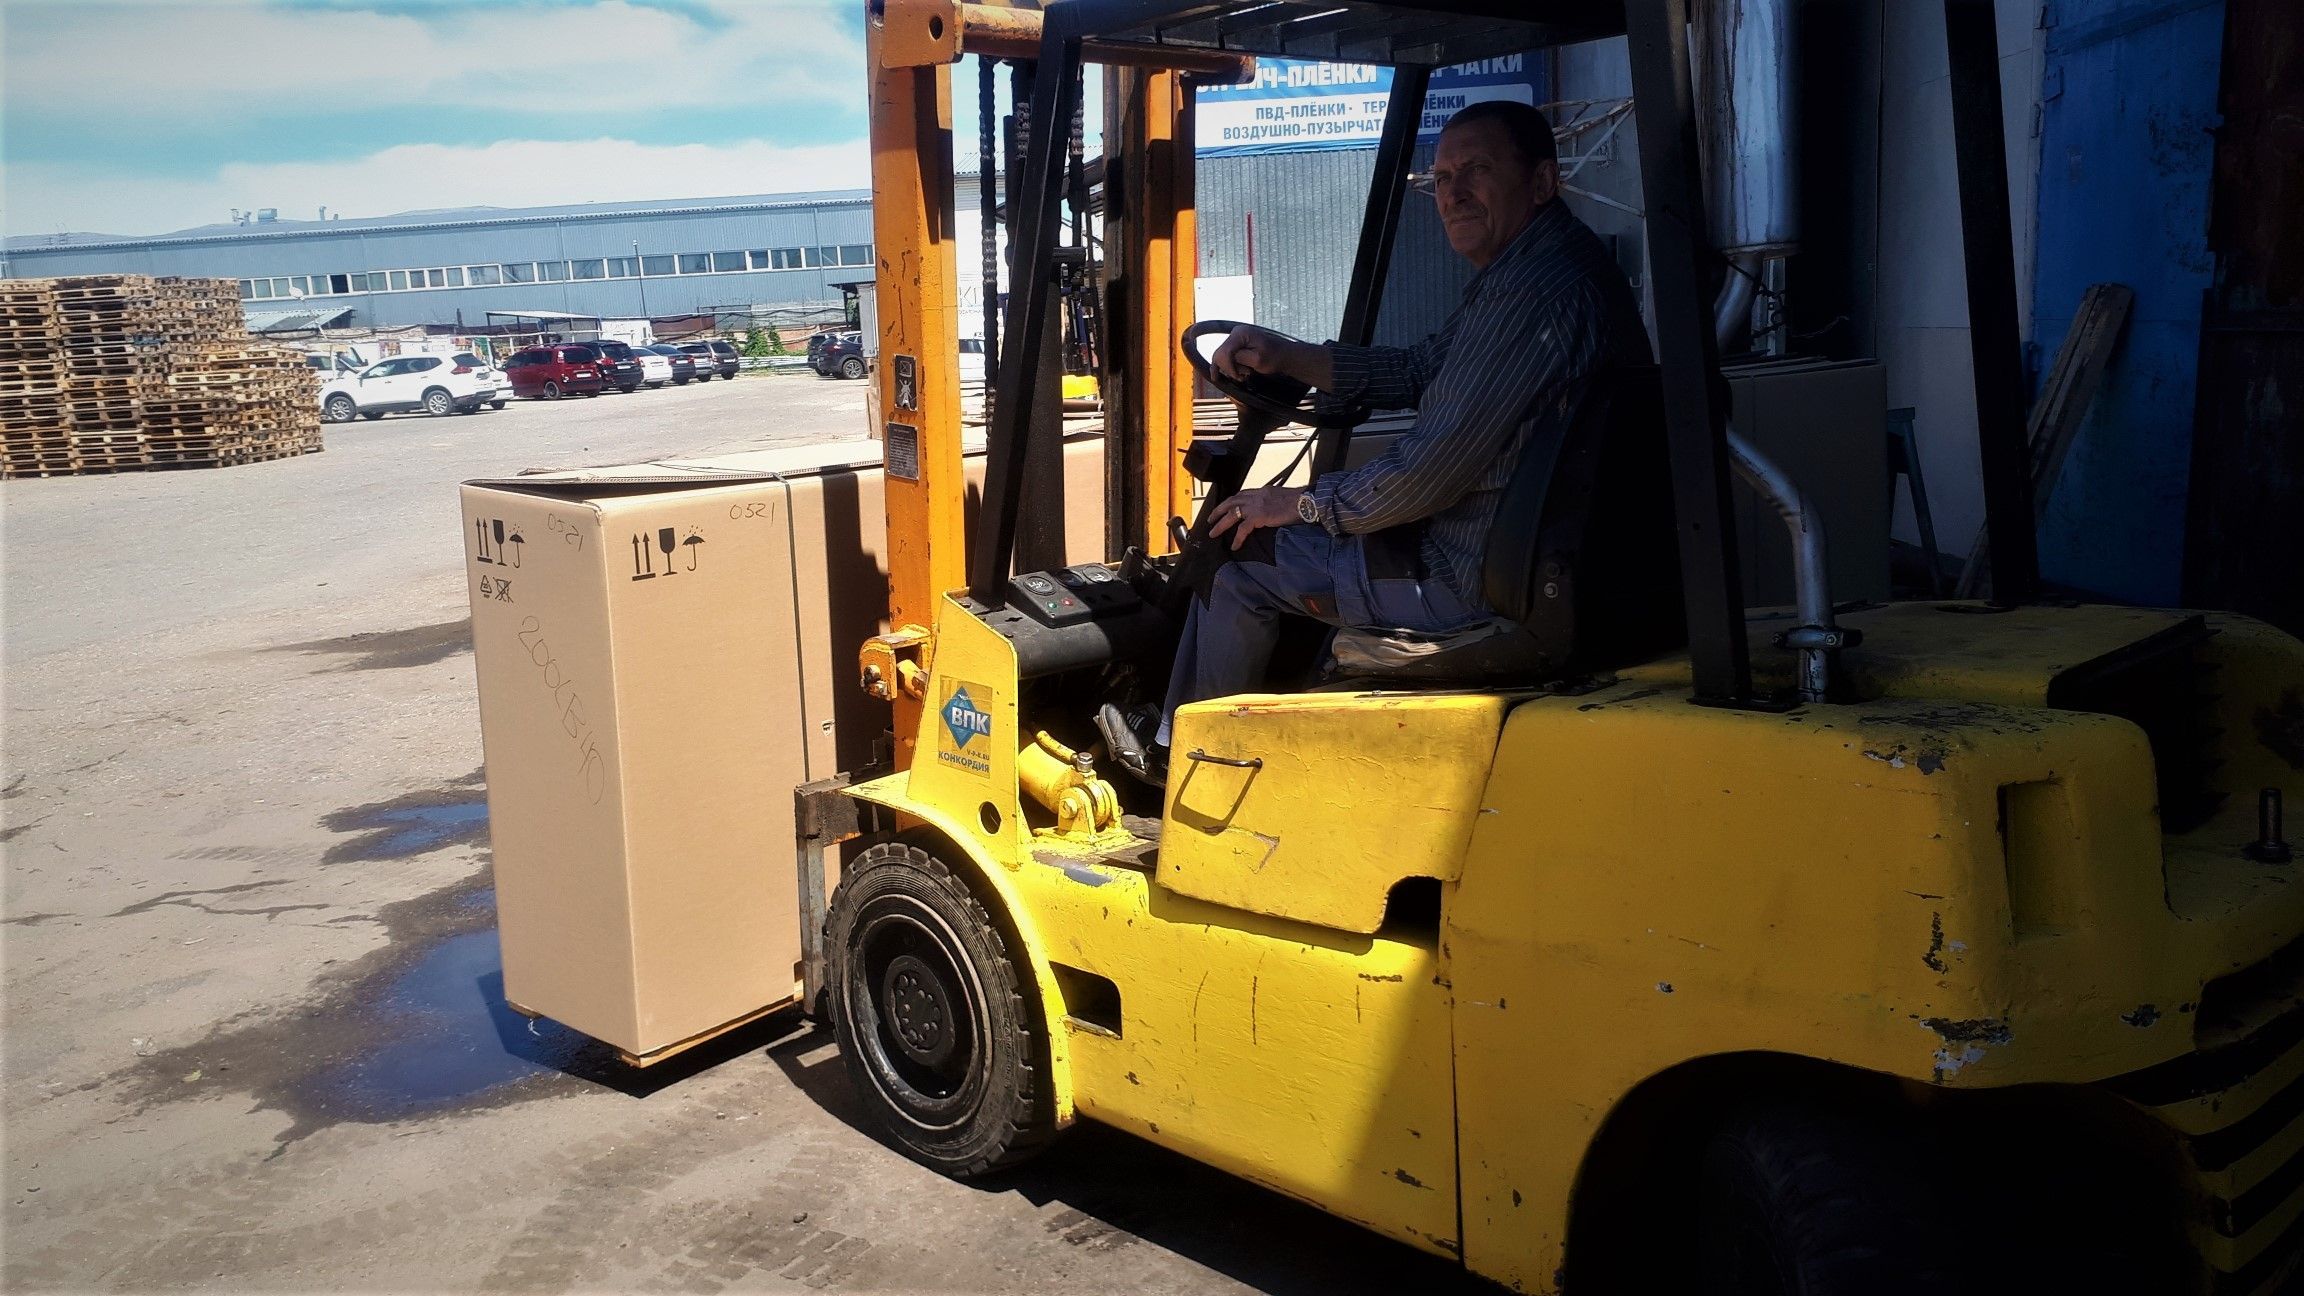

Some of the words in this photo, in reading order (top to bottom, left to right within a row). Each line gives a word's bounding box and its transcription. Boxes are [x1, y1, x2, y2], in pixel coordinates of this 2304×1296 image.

[1255, 101, 1346, 121] ПВД-ПЛЁНКИ
[1223, 118, 1382, 141] ВОЗДУШНО-ПУЗЫРЧАТ
[729, 502, 775, 527] 0521
[951, 706, 989, 734] ВПК
[938, 751, 990, 773] КОНКОРДИЯ
